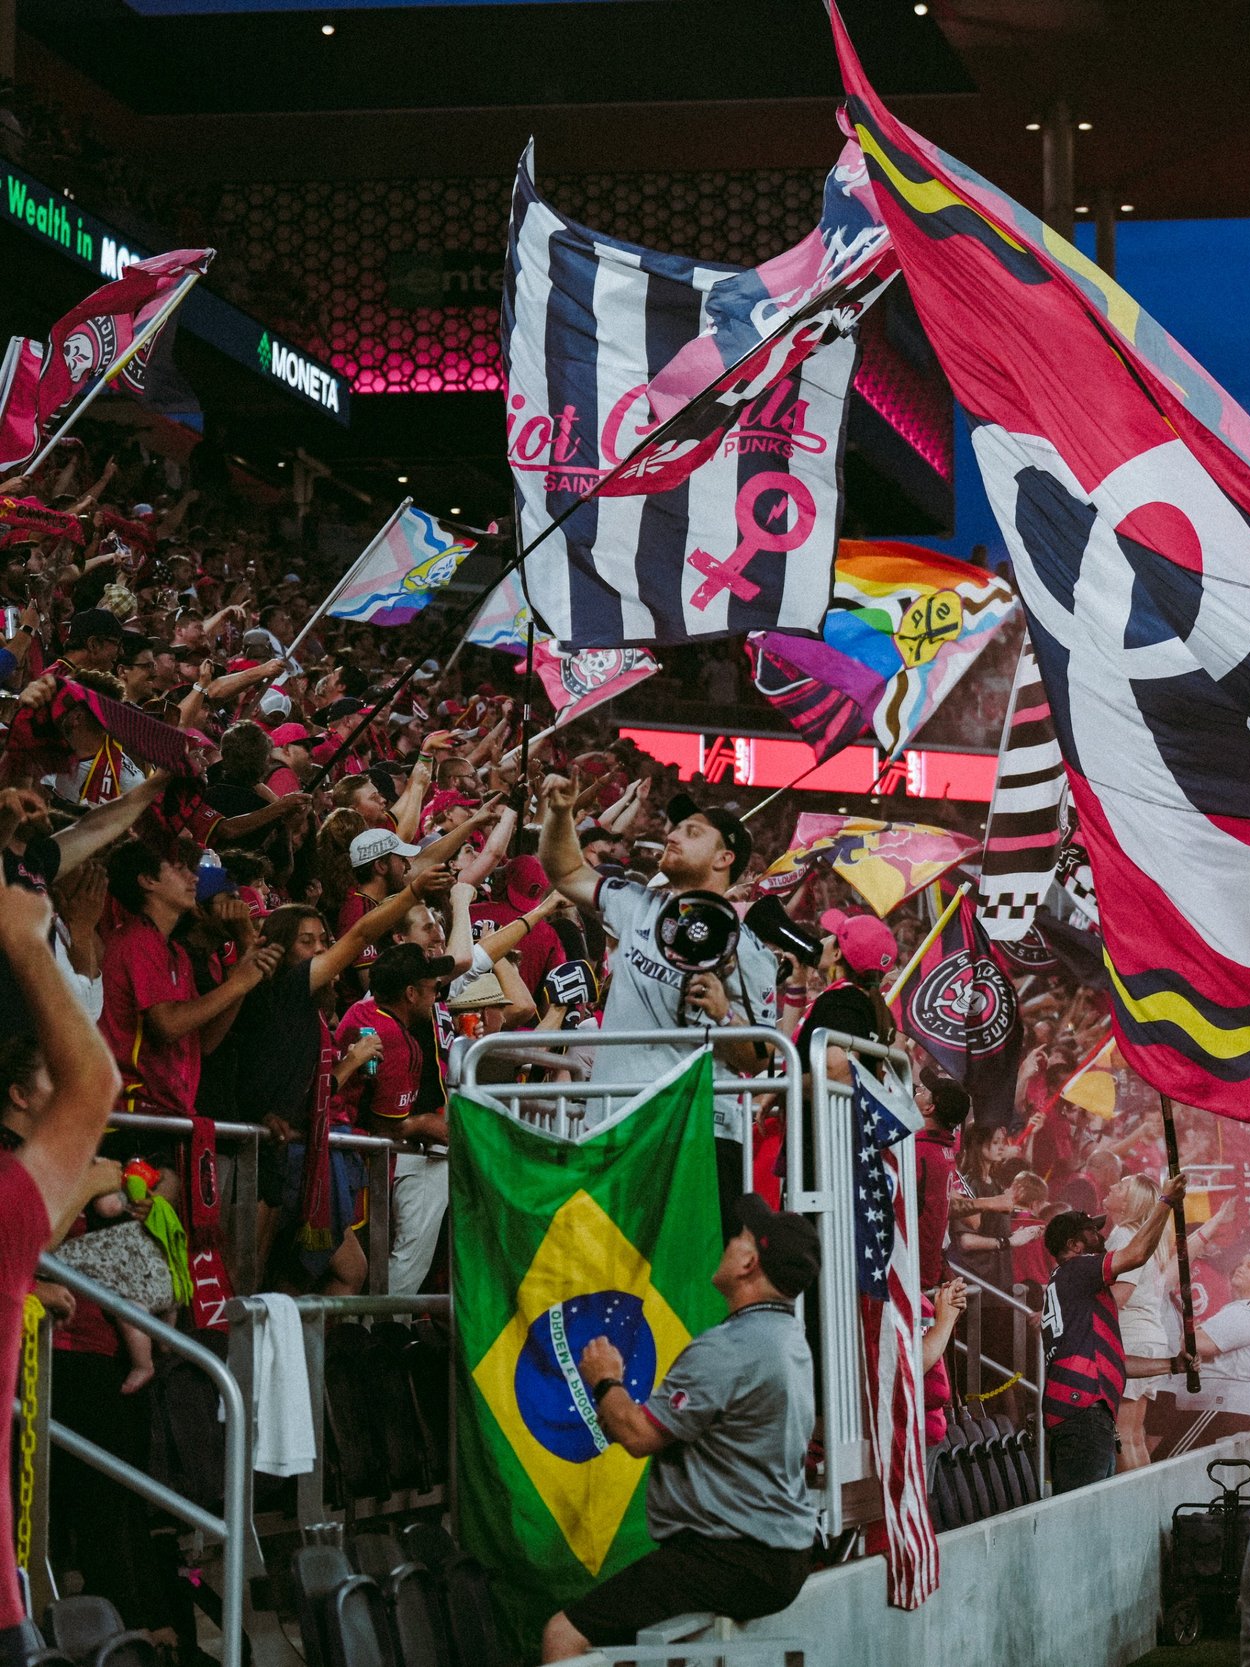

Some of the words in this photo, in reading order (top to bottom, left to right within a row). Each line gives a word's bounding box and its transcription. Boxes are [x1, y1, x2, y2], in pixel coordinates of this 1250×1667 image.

[8, 175, 71, 248] Wealth
[76, 217, 93, 262] in
[271, 341, 340, 413] MONETA
[724, 438, 794, 459] PUNKS
[543, 474, 601, 494] SAIN
